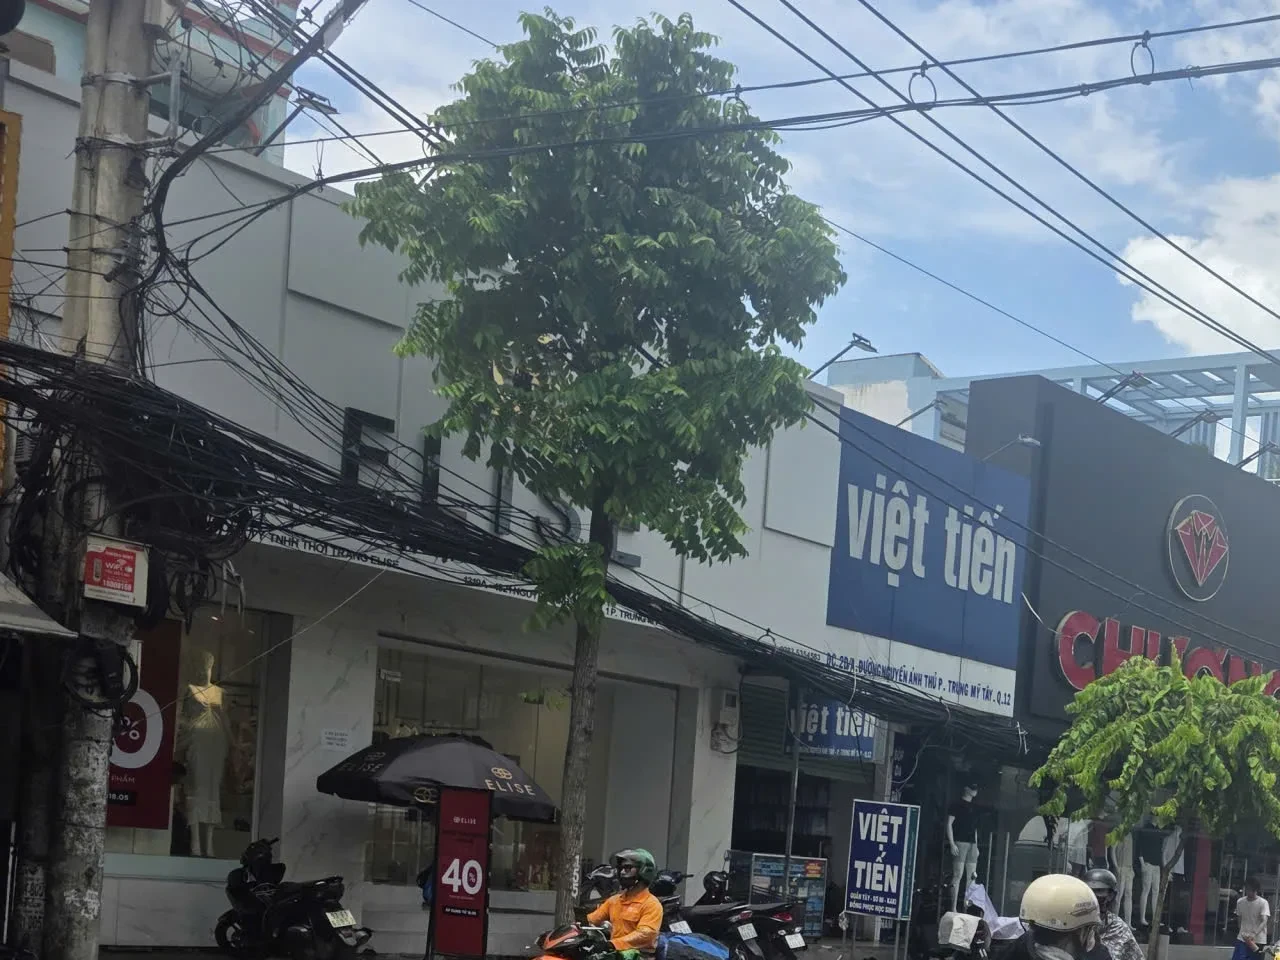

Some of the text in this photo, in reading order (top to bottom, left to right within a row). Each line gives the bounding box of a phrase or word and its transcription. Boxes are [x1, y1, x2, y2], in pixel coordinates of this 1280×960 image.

[847, 473, 1016, 604] việt tiến
[485, 779, 536, 796] ELISE
[858, 807, 902, 851] VIỆT
[441, 858, 483, 895] 40
[854, 852, 899, 893] TIẾN
